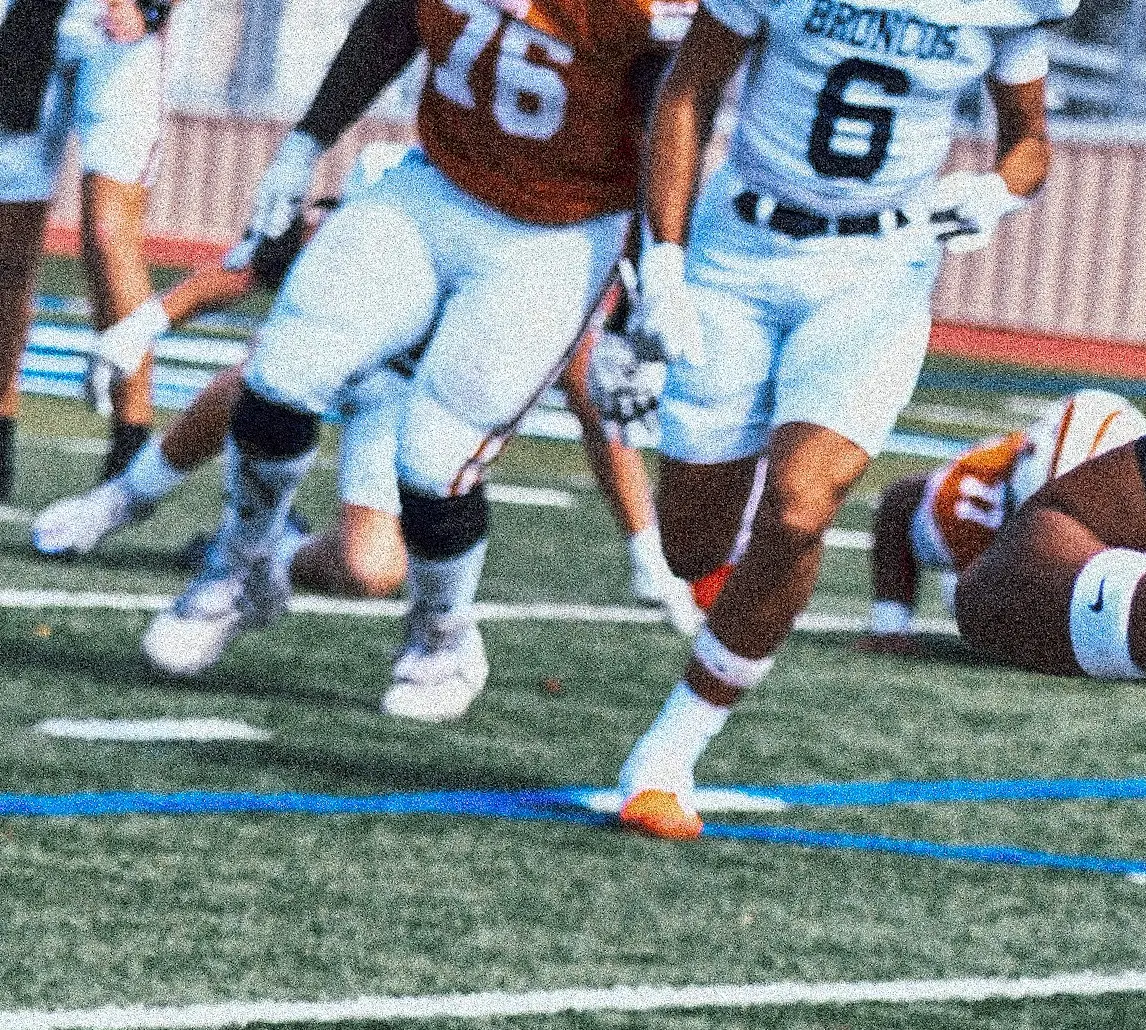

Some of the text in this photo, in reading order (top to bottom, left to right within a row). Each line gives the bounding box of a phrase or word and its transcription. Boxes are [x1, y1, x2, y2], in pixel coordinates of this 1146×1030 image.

[433, 0, 572, 141] 76
[803, 0, 959, 60] BRONCOS
[807, 57, 909, 181] 6
